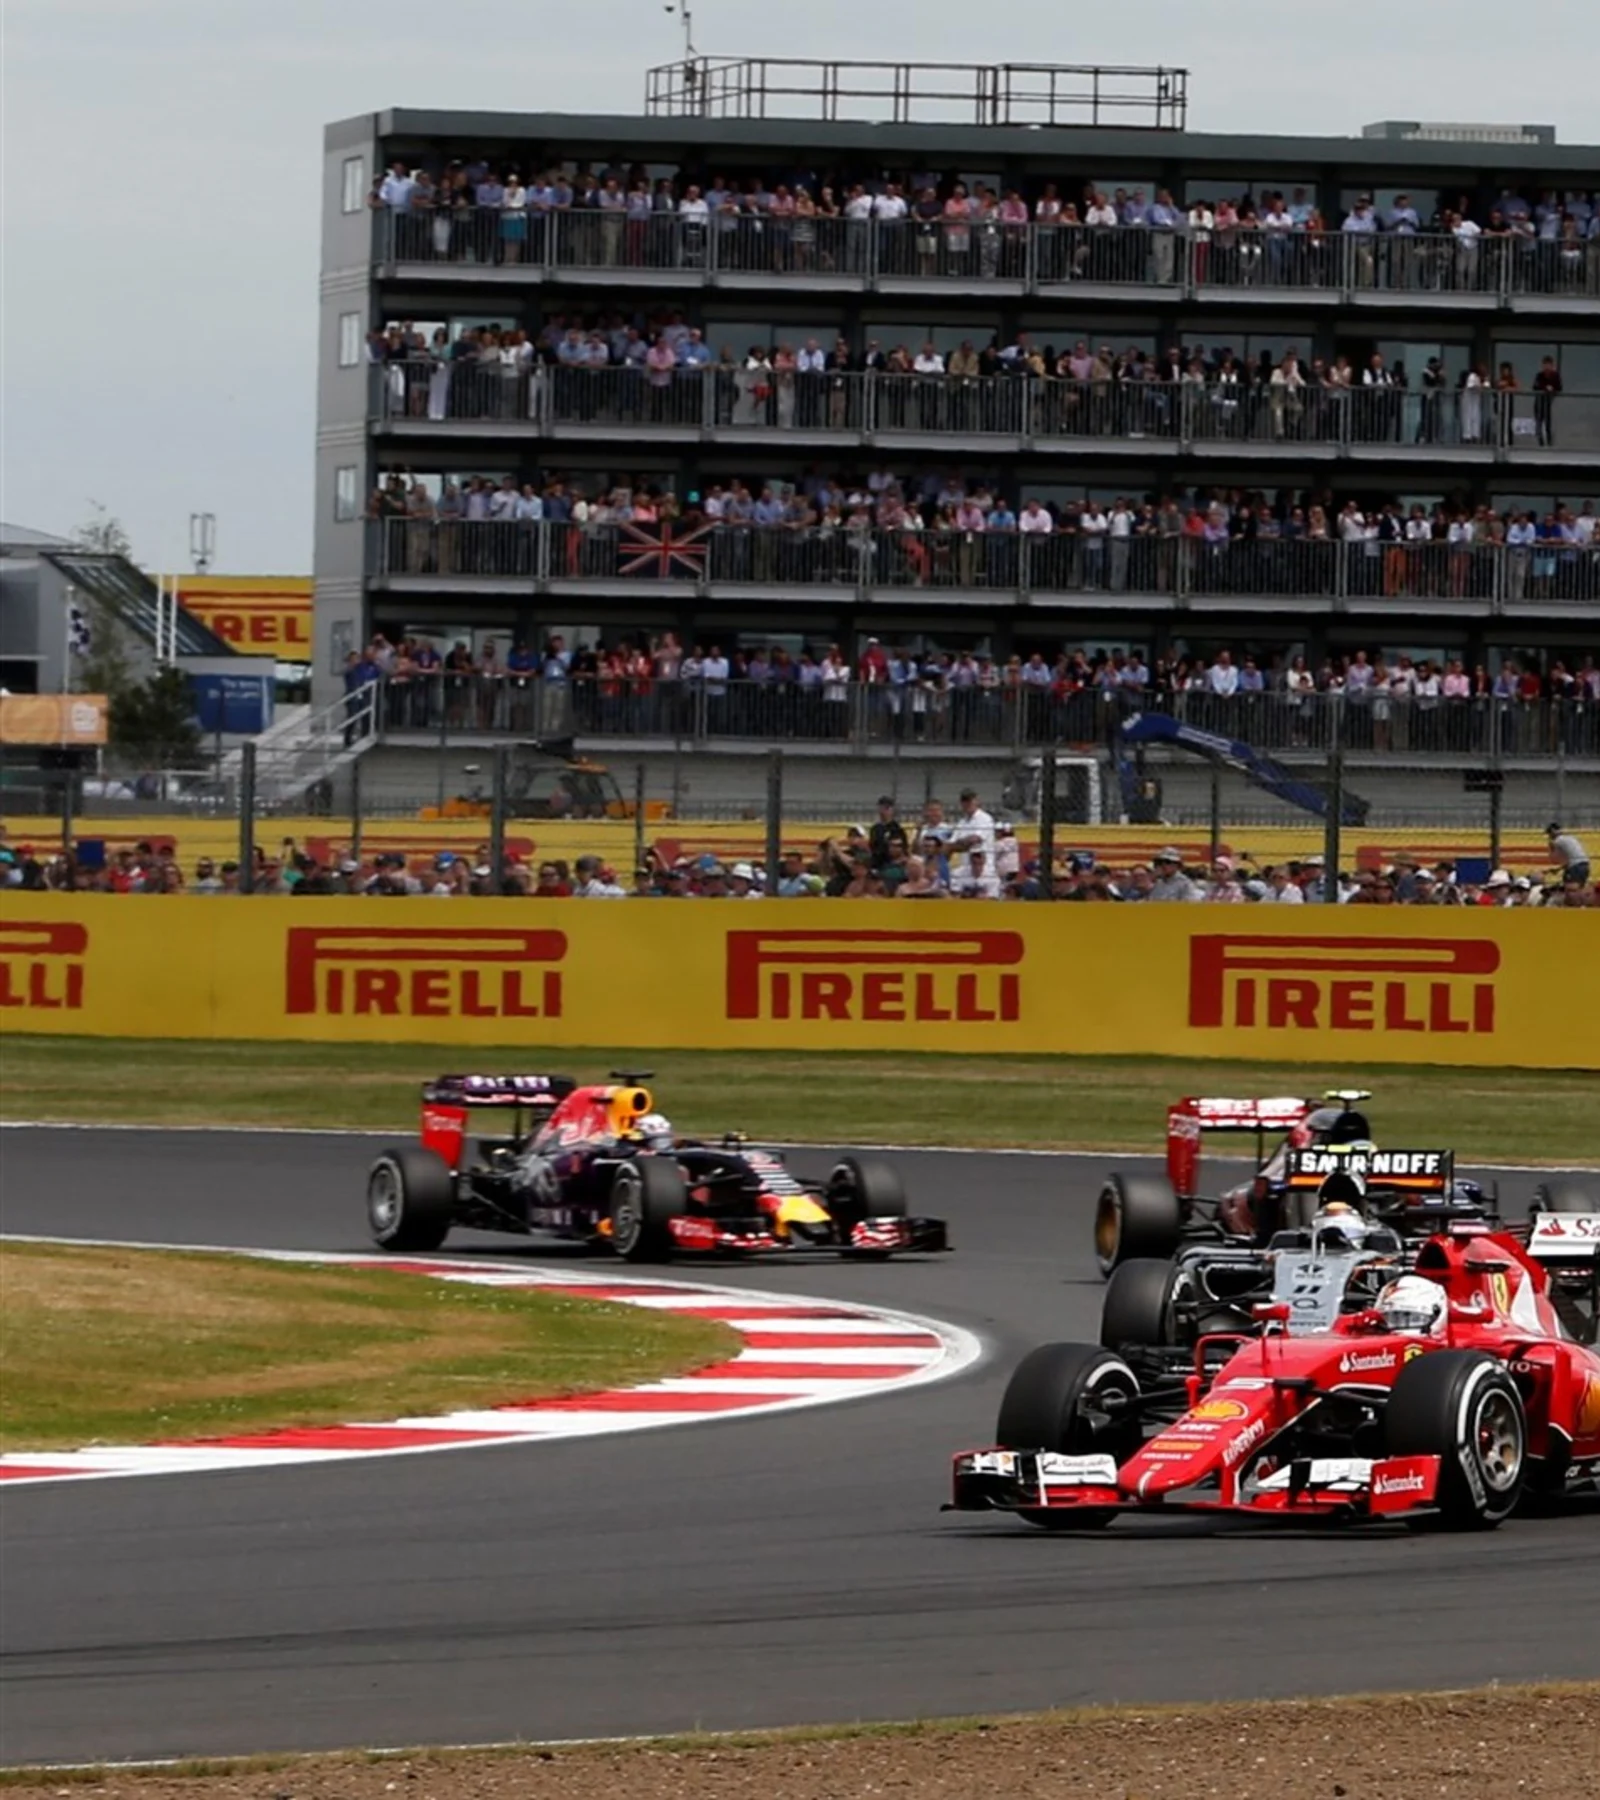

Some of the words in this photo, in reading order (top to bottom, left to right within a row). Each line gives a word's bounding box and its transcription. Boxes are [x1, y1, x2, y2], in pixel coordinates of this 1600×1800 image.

[286, 927, 567, 1017] PIRELLI
[726, 930, 1024, 1021] PIRELLI
[1189, 934, 1500, 1032] PIRELLI
